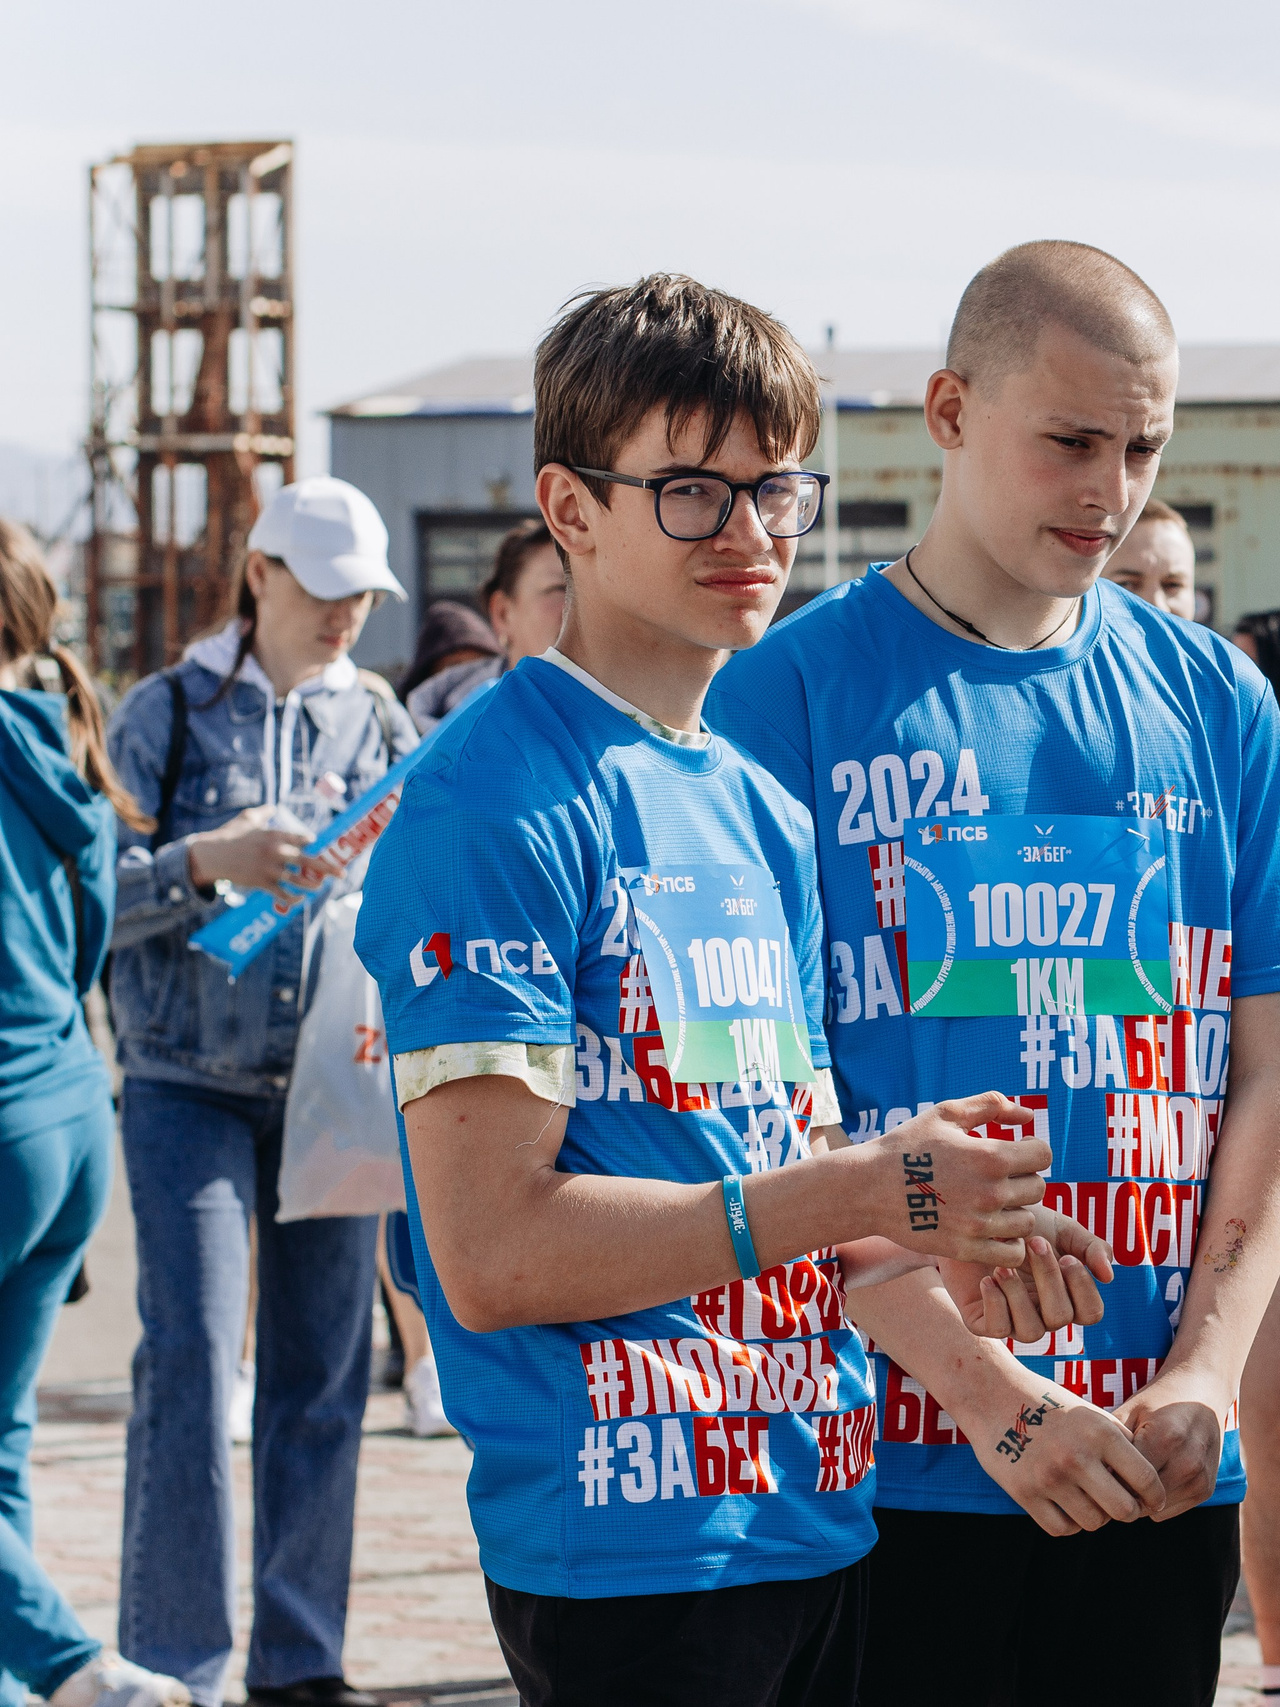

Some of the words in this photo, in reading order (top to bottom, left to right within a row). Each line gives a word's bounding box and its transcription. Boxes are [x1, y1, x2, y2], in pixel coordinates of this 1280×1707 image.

[831, 749, 990, 846] 2024
[948, 826, 988, 842] ПСБ
[662, 876, 696, 893] ПСБ
[969, 882, 1116, 948] 10027
[466, 938, 559, 977] ПСБ
[687, 937, 783, 1008] 10047
[586, 1337, 838, 1417] #ЛЮБОВЬ
[578, 1417, 774, 1507] #ЗАБЕГ
